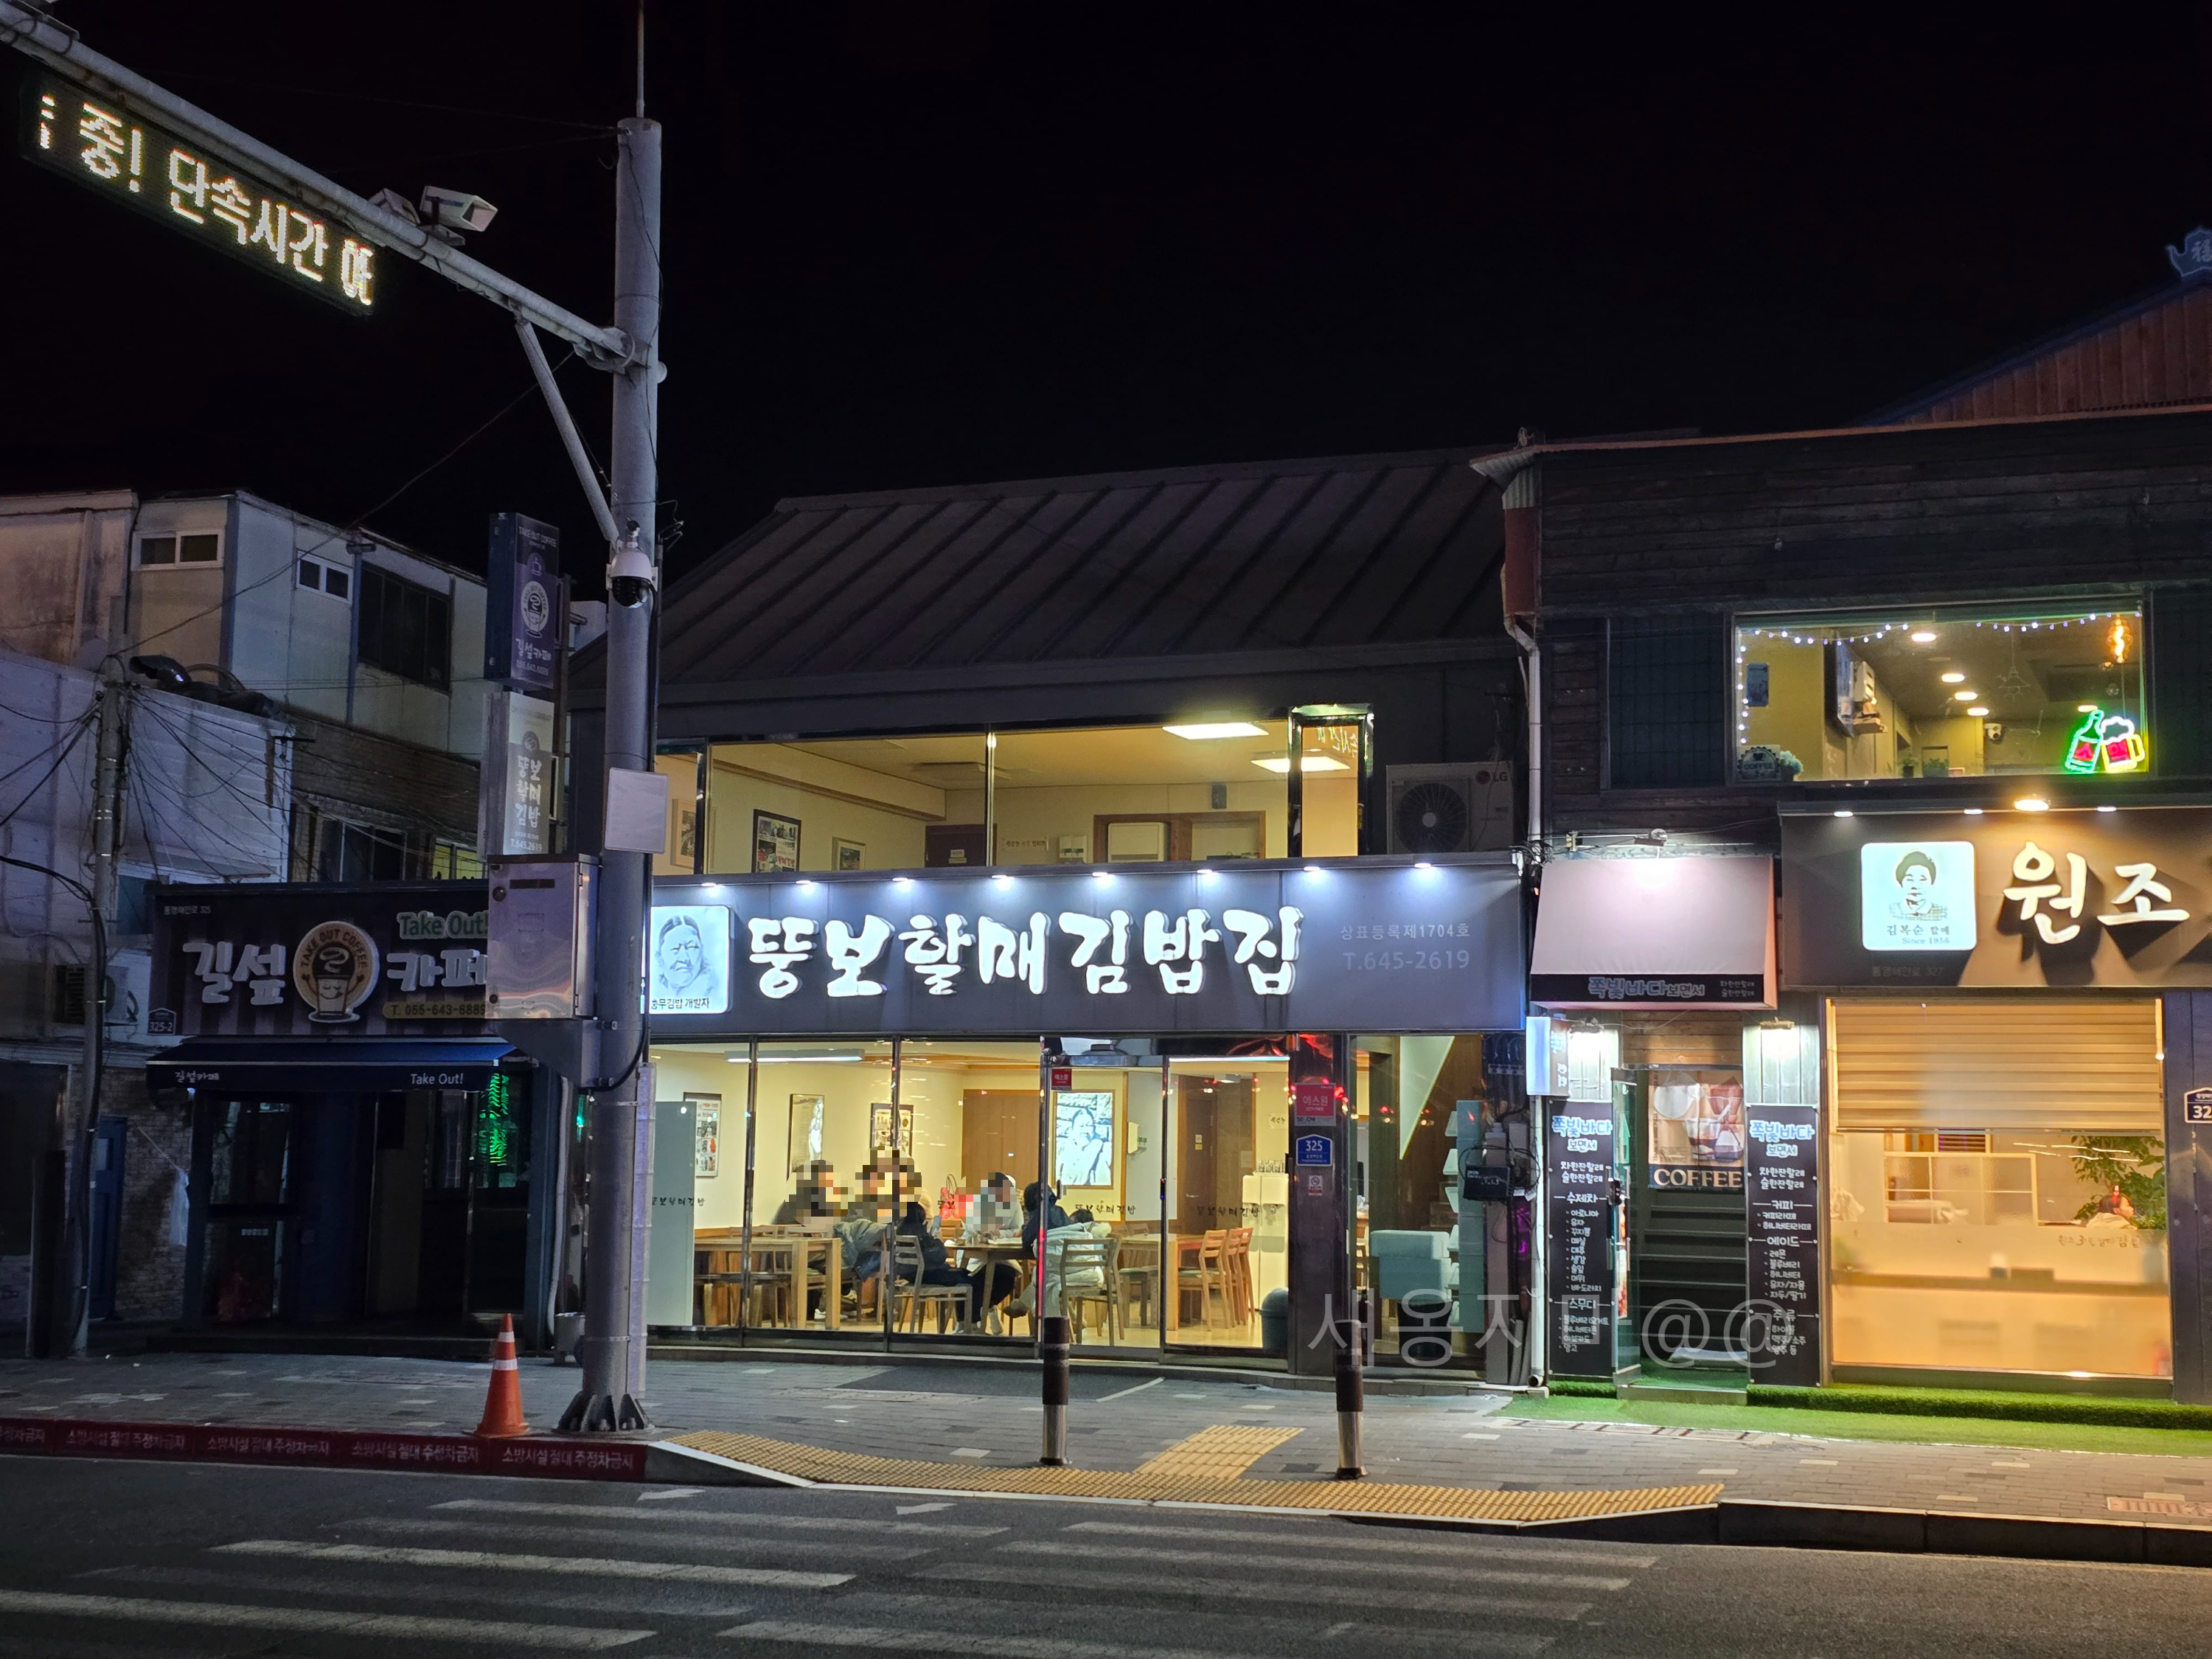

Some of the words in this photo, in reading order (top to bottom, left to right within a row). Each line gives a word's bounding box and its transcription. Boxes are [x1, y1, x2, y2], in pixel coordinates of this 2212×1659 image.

[169, 148, 329, 282] 단속시간
[515, 637, 552, 662] 길섶카페
[517, 755, 543, 782] 뚱보
[516, 779, 542, 806] 할매
[515, 802, 541, 829] 김밥
[2002, 841, 2191, 945] 원조
[398, 914, 443, 936] Take
[1886, 924, 1924, 936] 김복순
[300, 936, 319, 969] TAKE
[319, 929, 341, 942] OUT
[342, 931, 369, 970] COFFEE
[747, 905, 1304, 1000] 뚱보할매김밥집
[1343, 949, 1470, 972] T.645-2619
[182, 941, 286, 1005] 길섶
[685, 997, 709, 1009] 개발자
[148, 1021, 173, 1032] 325-2
[174, 1070, 220, 1084] 길섶카페
[410, 1073, 435, 1085] Take
[439, 1072, 465, 1085] Out!
[1302, 1095, 1329, 1107] 에스원
[1551, 1116, 1613, 1138] 쪽빛바다
[1749, 1119, 1815, 1143] 쪽빛바다
[1305, 1140, 1324, 1152] 325
[1567, 1138, 1598, 1152] 보면서
[1766, 1143, 1798, 1158] 보면서
[1562, 1171, 1604, 1184] 술한잔할래
[1653, 1168, 1743, 1188] COFFEE
[1760, 1177, 1804, 1190] 술한잔할래
[1567, 1191, 1599, 1204] 수제차
[1771, 1200, 1794, 1210] 커피
[1571, 1208, 1600, 1217] 아로니아
[1762, 1211, 1797, 1220] 커피라떼
[1571, 1218, 1585, 1226] 유자
[1571, 1227, 1591, 1237] 꾸지뽕
[1767, 1236, 1801, 1248] 에이드
[1769, 1249, 1786, 1259] 레몬
[1770, 1259, 1801, 1270] 블루베리
[1770, 1290, 1806, 1301] 자두/딸기
[1569, 1298, 1596, 1310] 스무디
[1563, 1343, 1578, 1353] 망고
[502, 1445, 549, 1466] 소방시설
[549, 1448, 572, 1467] 절대
[574, 1450, 634, 1471] 주정차금지
